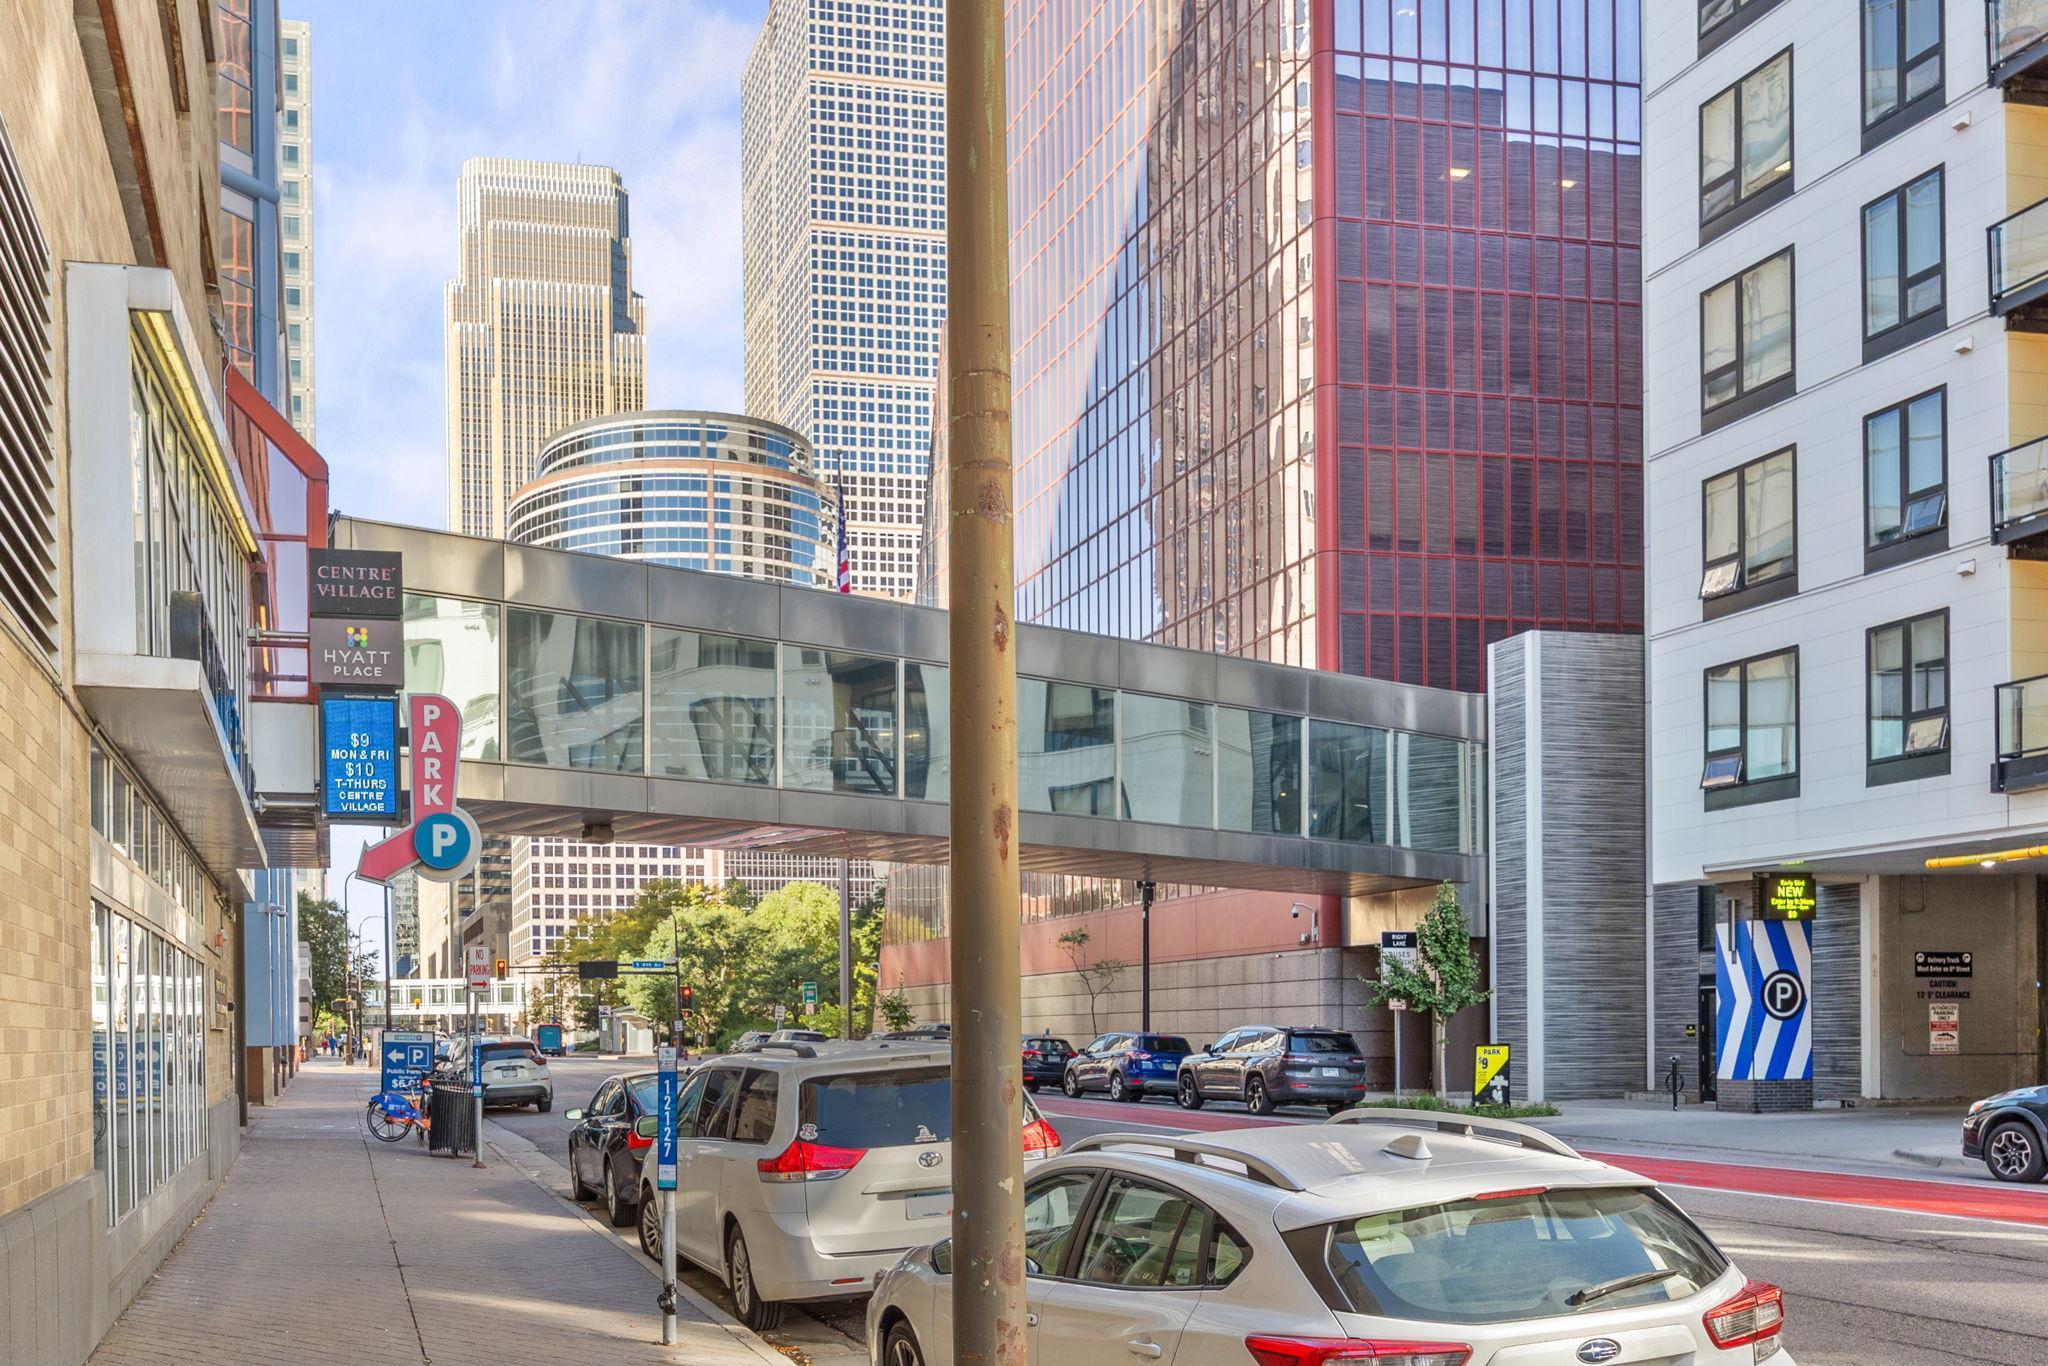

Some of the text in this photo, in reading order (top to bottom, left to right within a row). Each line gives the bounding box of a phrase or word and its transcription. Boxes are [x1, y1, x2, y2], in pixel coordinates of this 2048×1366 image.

[316, 584, 396, 599] VILLAGE
[324, 649, 391, 665] HYATT
[333, 665, 383, 677] PLACE
[350, 732, 370, 749] $9
[331, 749, 390, 761] MON & FRI
[420, 704, 445, 806] PARK
[345, 762, 374, 777] $10
[334, 778, 388, 790] T-THURS
[340, 802, 385, 812] VILLAGE
[432, 823, 457, 858] P
[1777, 886, 1804, 898] NEW
[475, 949, 484, 960] NO
[469, 964, 491, 975] PARKING
[1776, 982, 1793, 1010] P
[412, 1049, 424, 1064] P
[1483, 1048, 1501, 1056] PARK
[1478, 1056, 1489, 1070] $9
[663, 1079, 671, 1158] 12127
